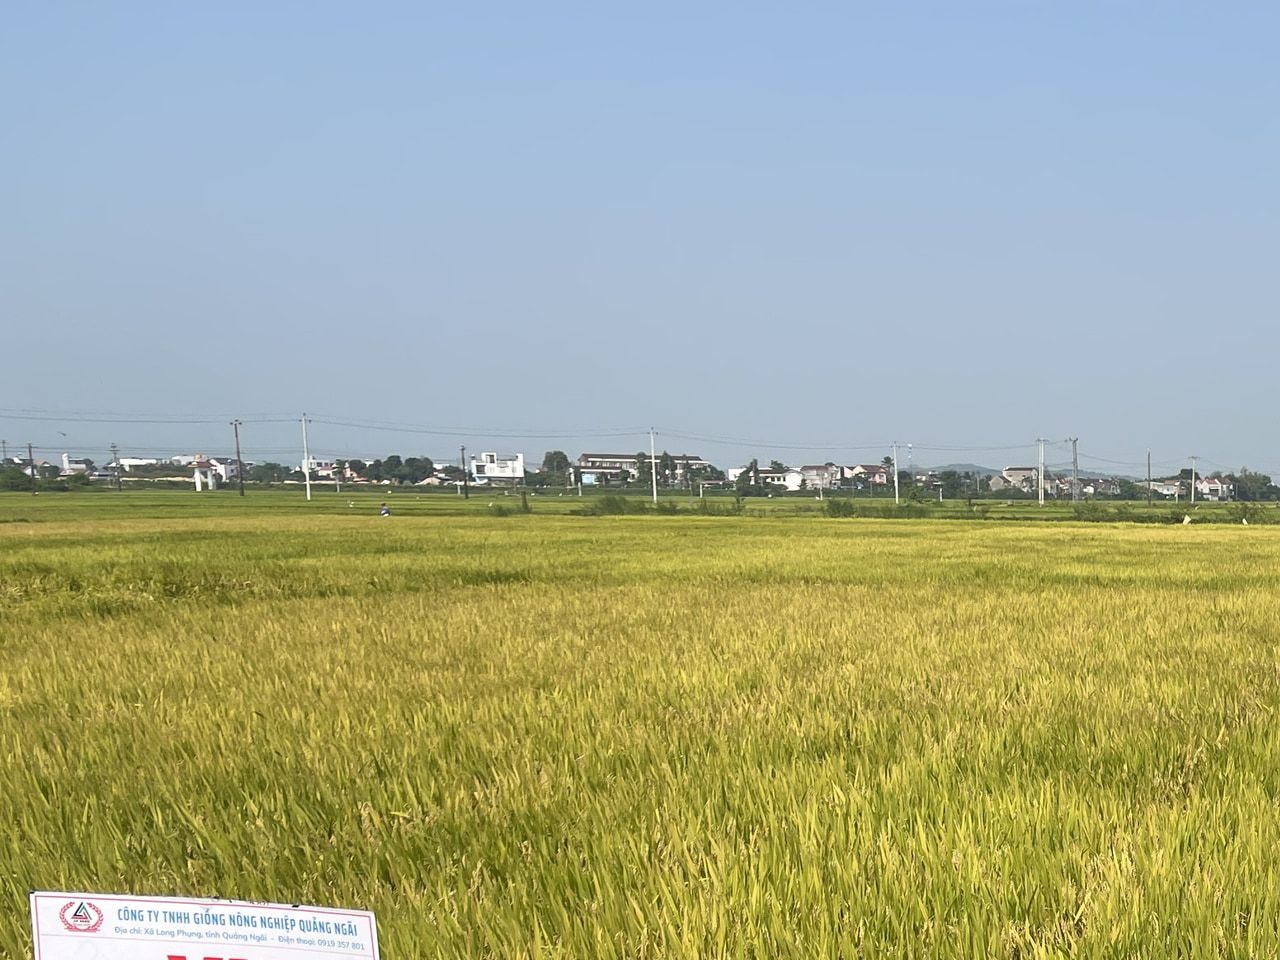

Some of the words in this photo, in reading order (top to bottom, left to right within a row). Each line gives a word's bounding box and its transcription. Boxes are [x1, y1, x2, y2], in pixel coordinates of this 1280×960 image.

[118, 906, 144, 922] CÔNG
[147, 910, 159, 922] TY
[162, 911, 190, 924] TNHH
[194, 908, 226, 926] GIỐNG
[229, 912, 257, 928] NÔNG
[260, 915, 296, 933] NGHIỆP
[299, 916, 332, 934] QUẢNG
[334, 920, 358, 936] NGÃI
[156, 928, 175, 938] Long
